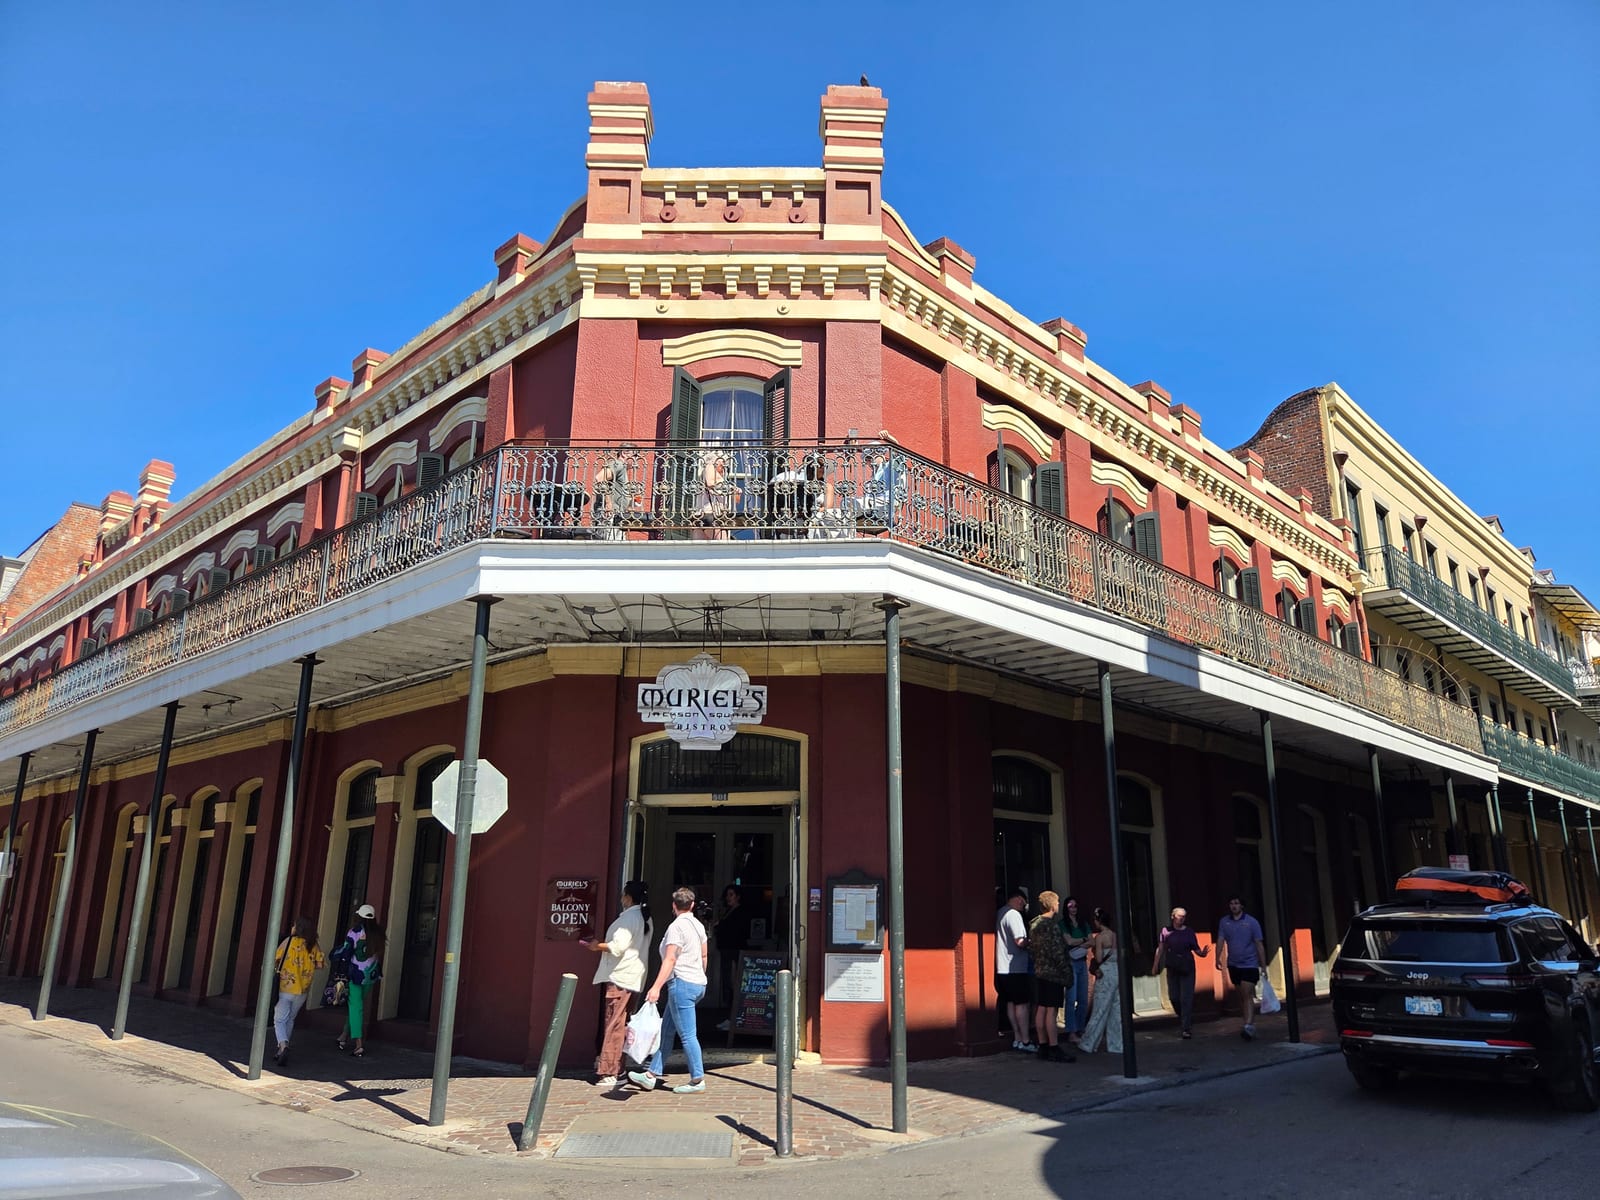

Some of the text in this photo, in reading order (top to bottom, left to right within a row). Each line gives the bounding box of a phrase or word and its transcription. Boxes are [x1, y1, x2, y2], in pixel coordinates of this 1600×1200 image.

[641, 688, 765, 721] MURIEL'S
[677, 723, 726, 731] BISTRO
[556, 880, 589, 889] MURIEL'S
[551, 903, 590, 912] BALCONY
[550, 912, 589, 925] OPEN
[1406, 971, 1429, 980] Jeep
